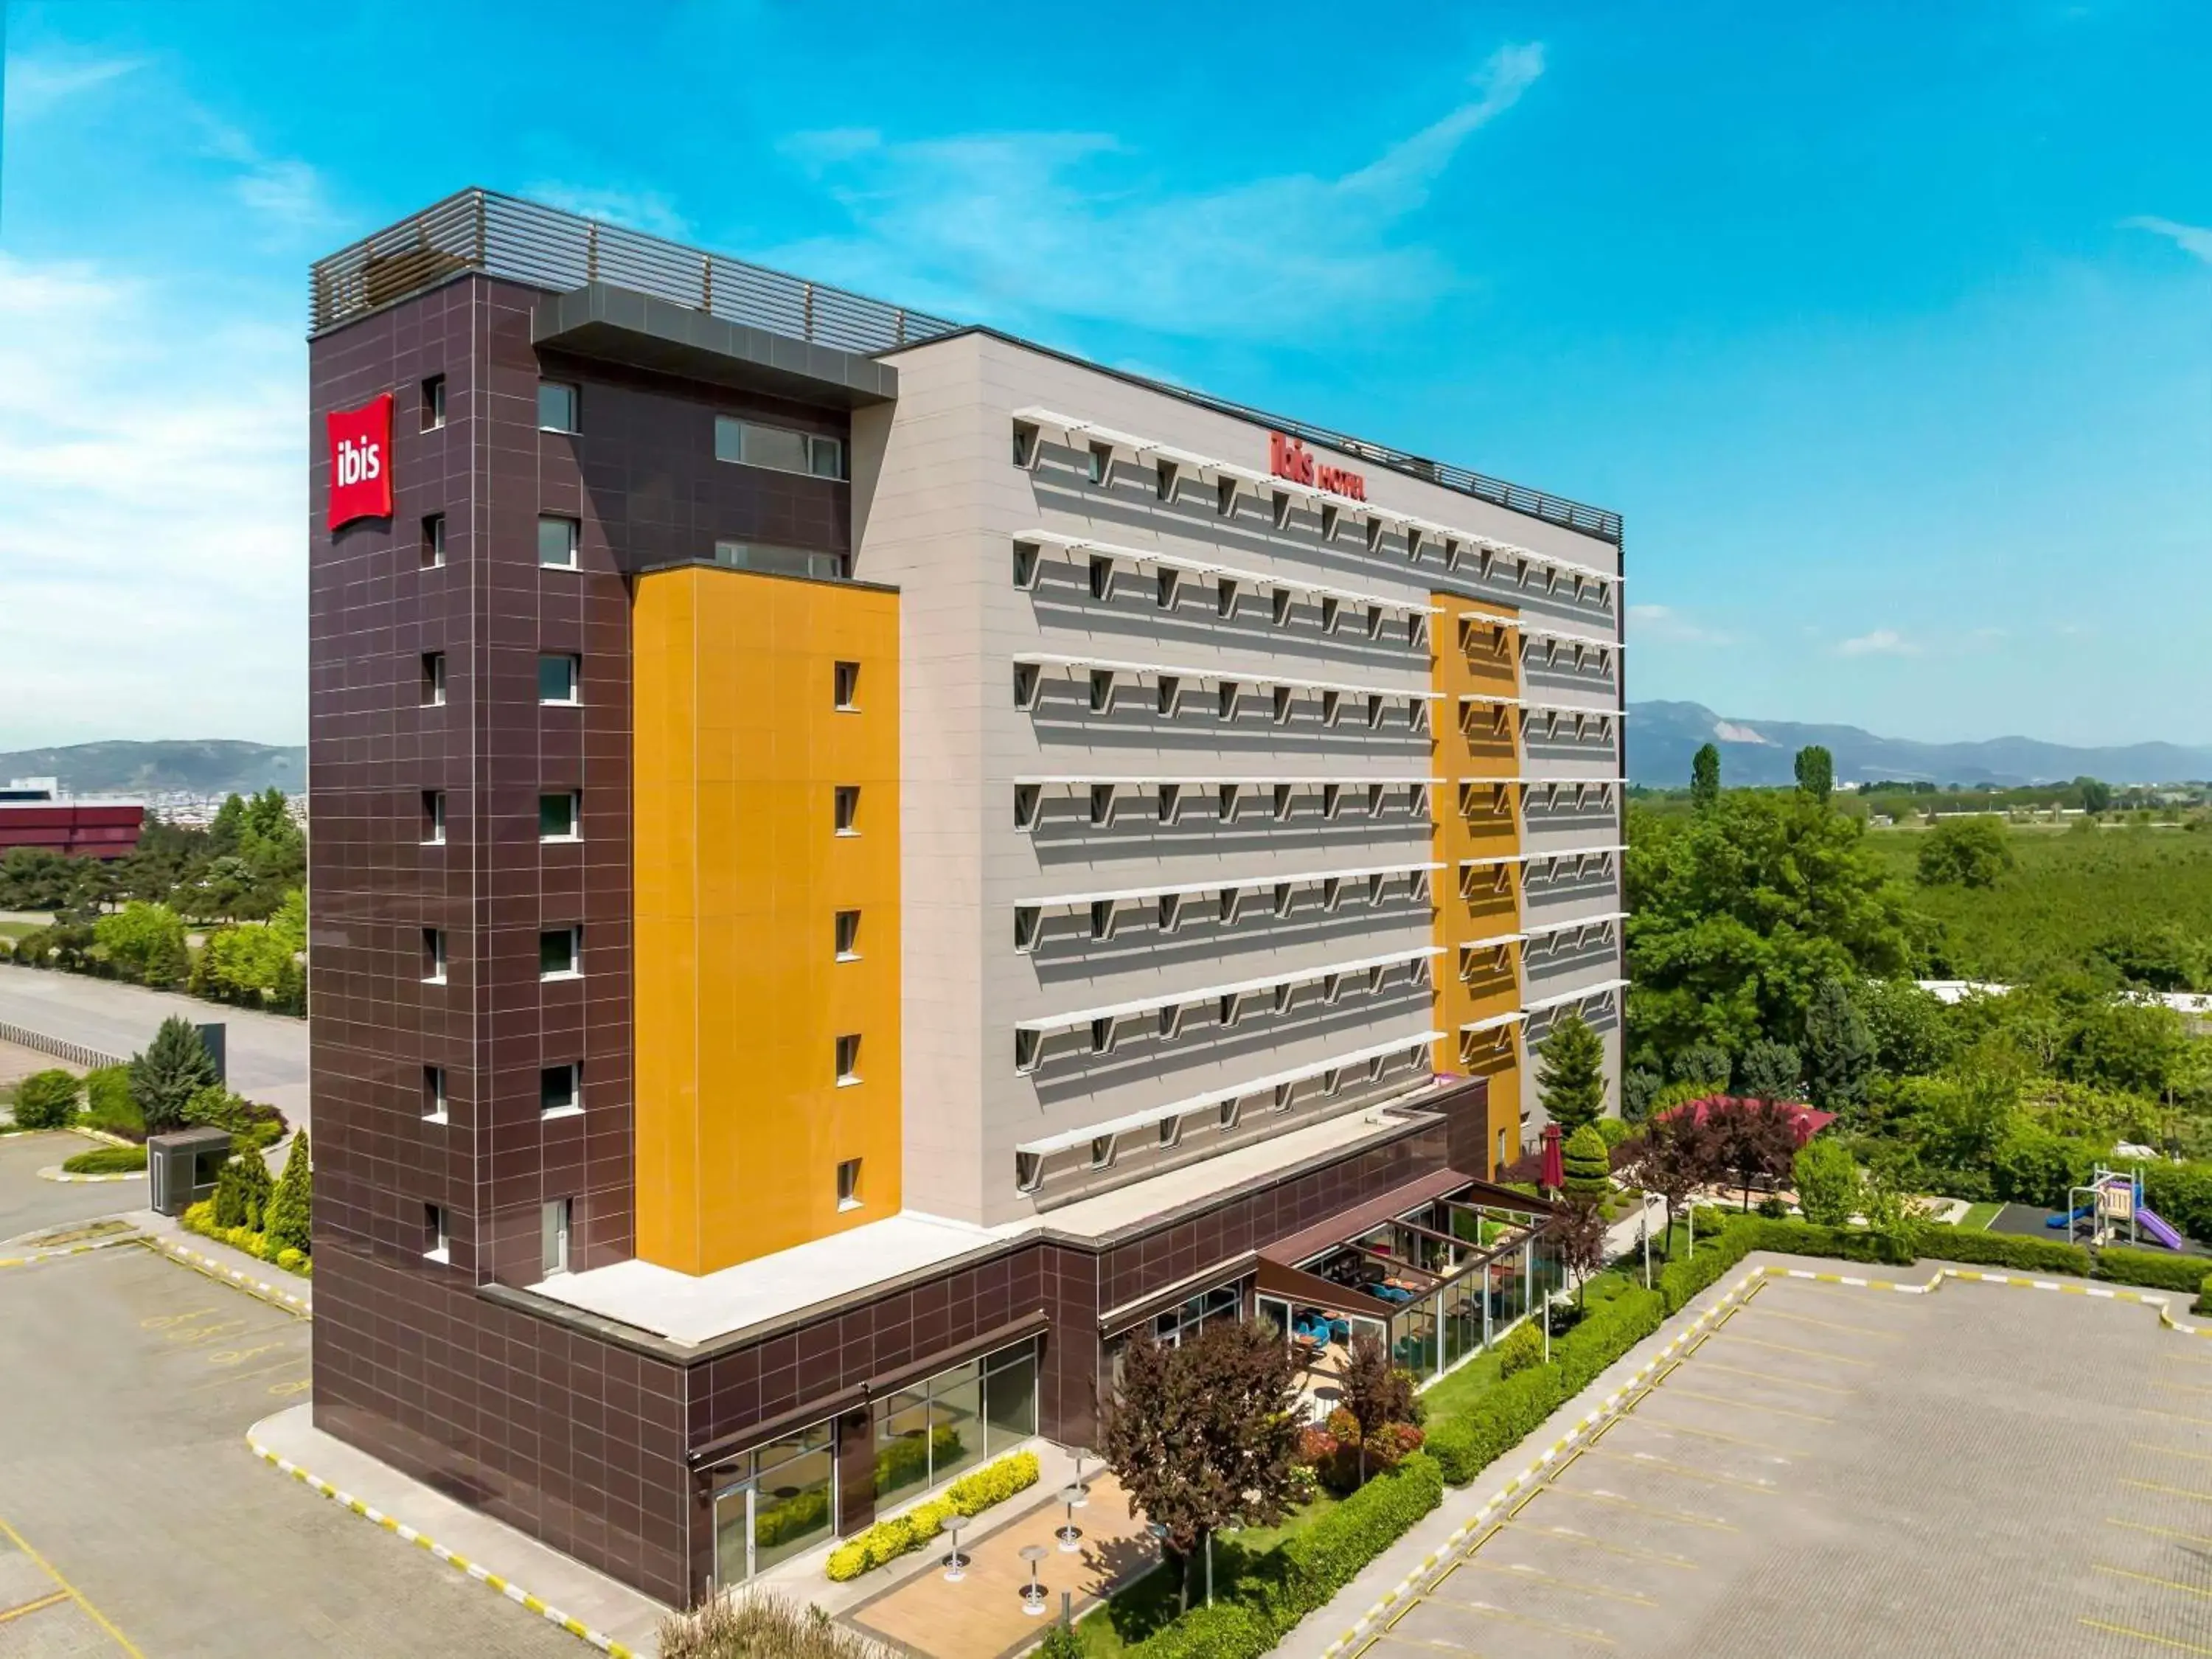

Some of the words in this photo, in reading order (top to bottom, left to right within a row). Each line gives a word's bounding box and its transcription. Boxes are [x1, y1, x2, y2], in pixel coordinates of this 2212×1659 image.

[338, 435, 380, 487] ibis
[1270, 431, 1313, 487] ibis
[1318, 465, 1366, 503] HOTEL
